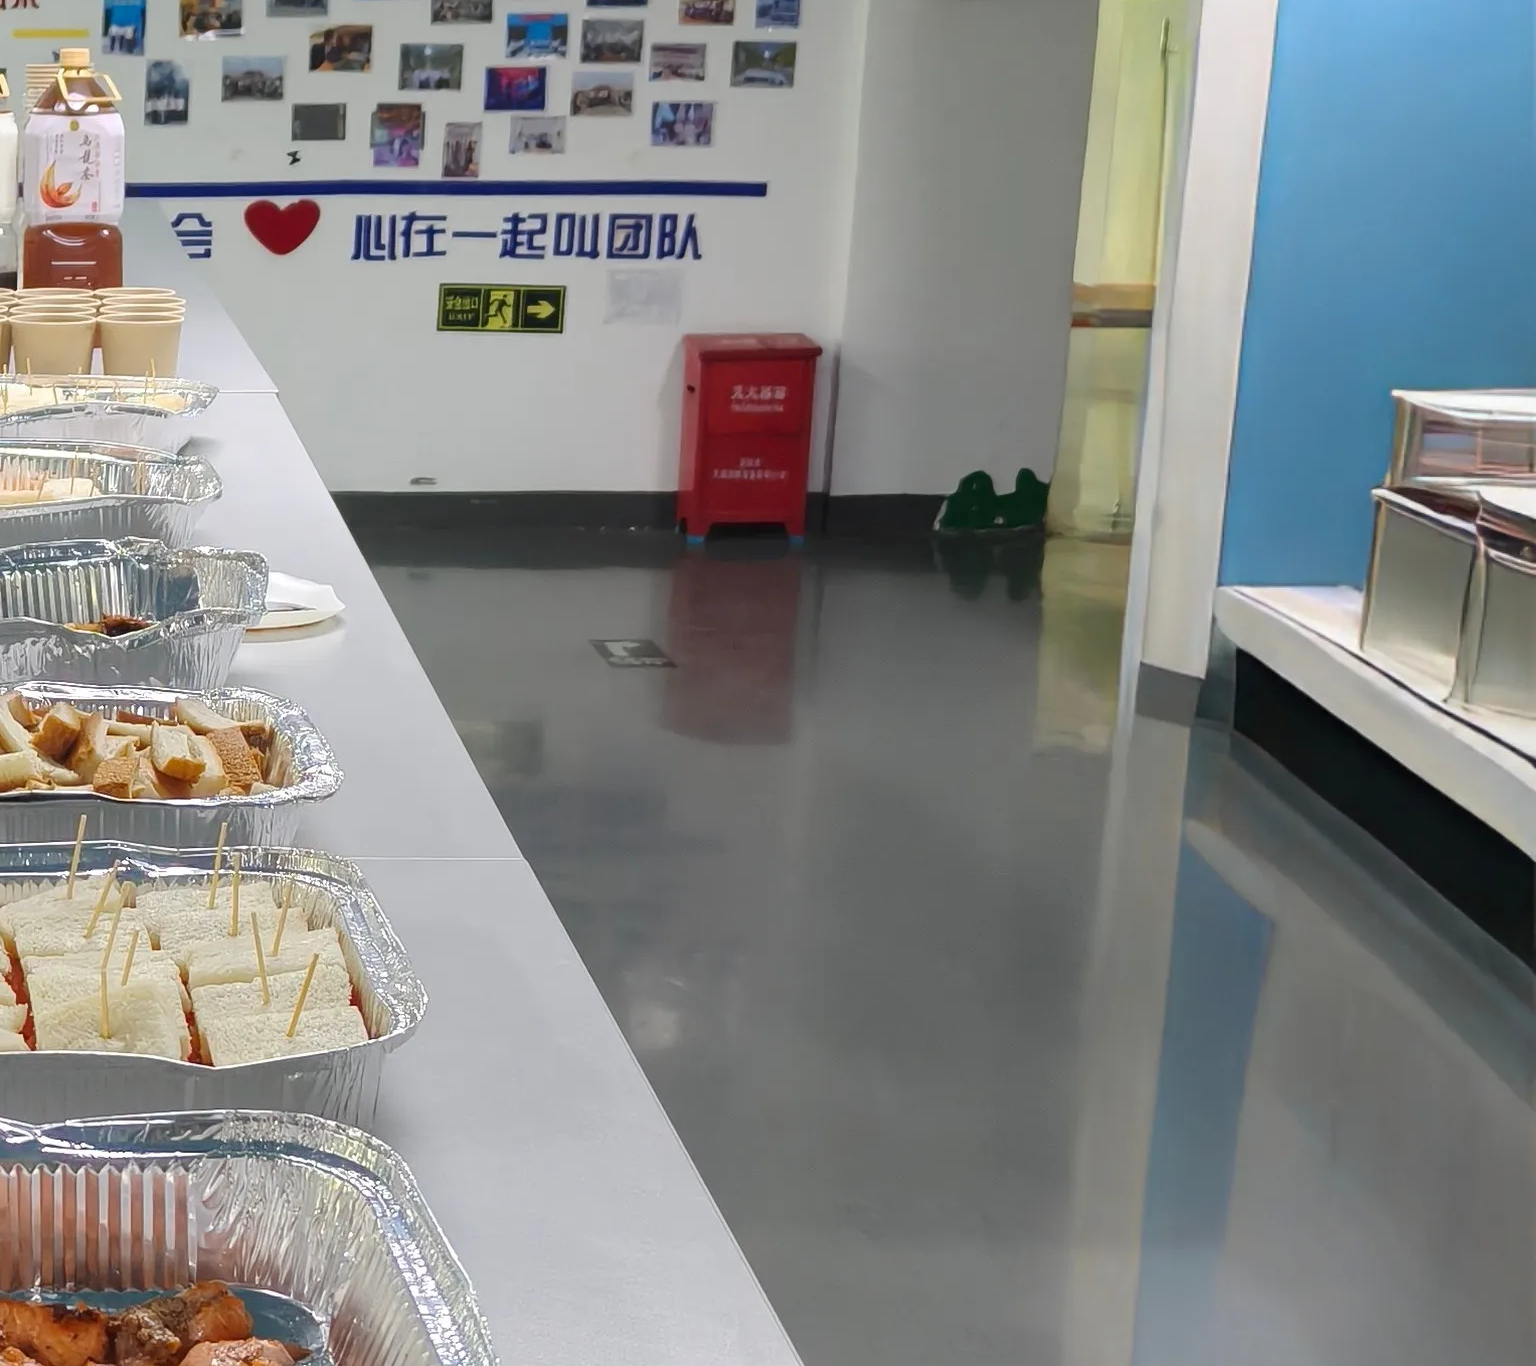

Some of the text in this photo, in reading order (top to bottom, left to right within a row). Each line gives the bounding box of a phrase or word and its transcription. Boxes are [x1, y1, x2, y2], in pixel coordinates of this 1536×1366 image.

[351, 211, 703, 261] 心在一起叫团队
